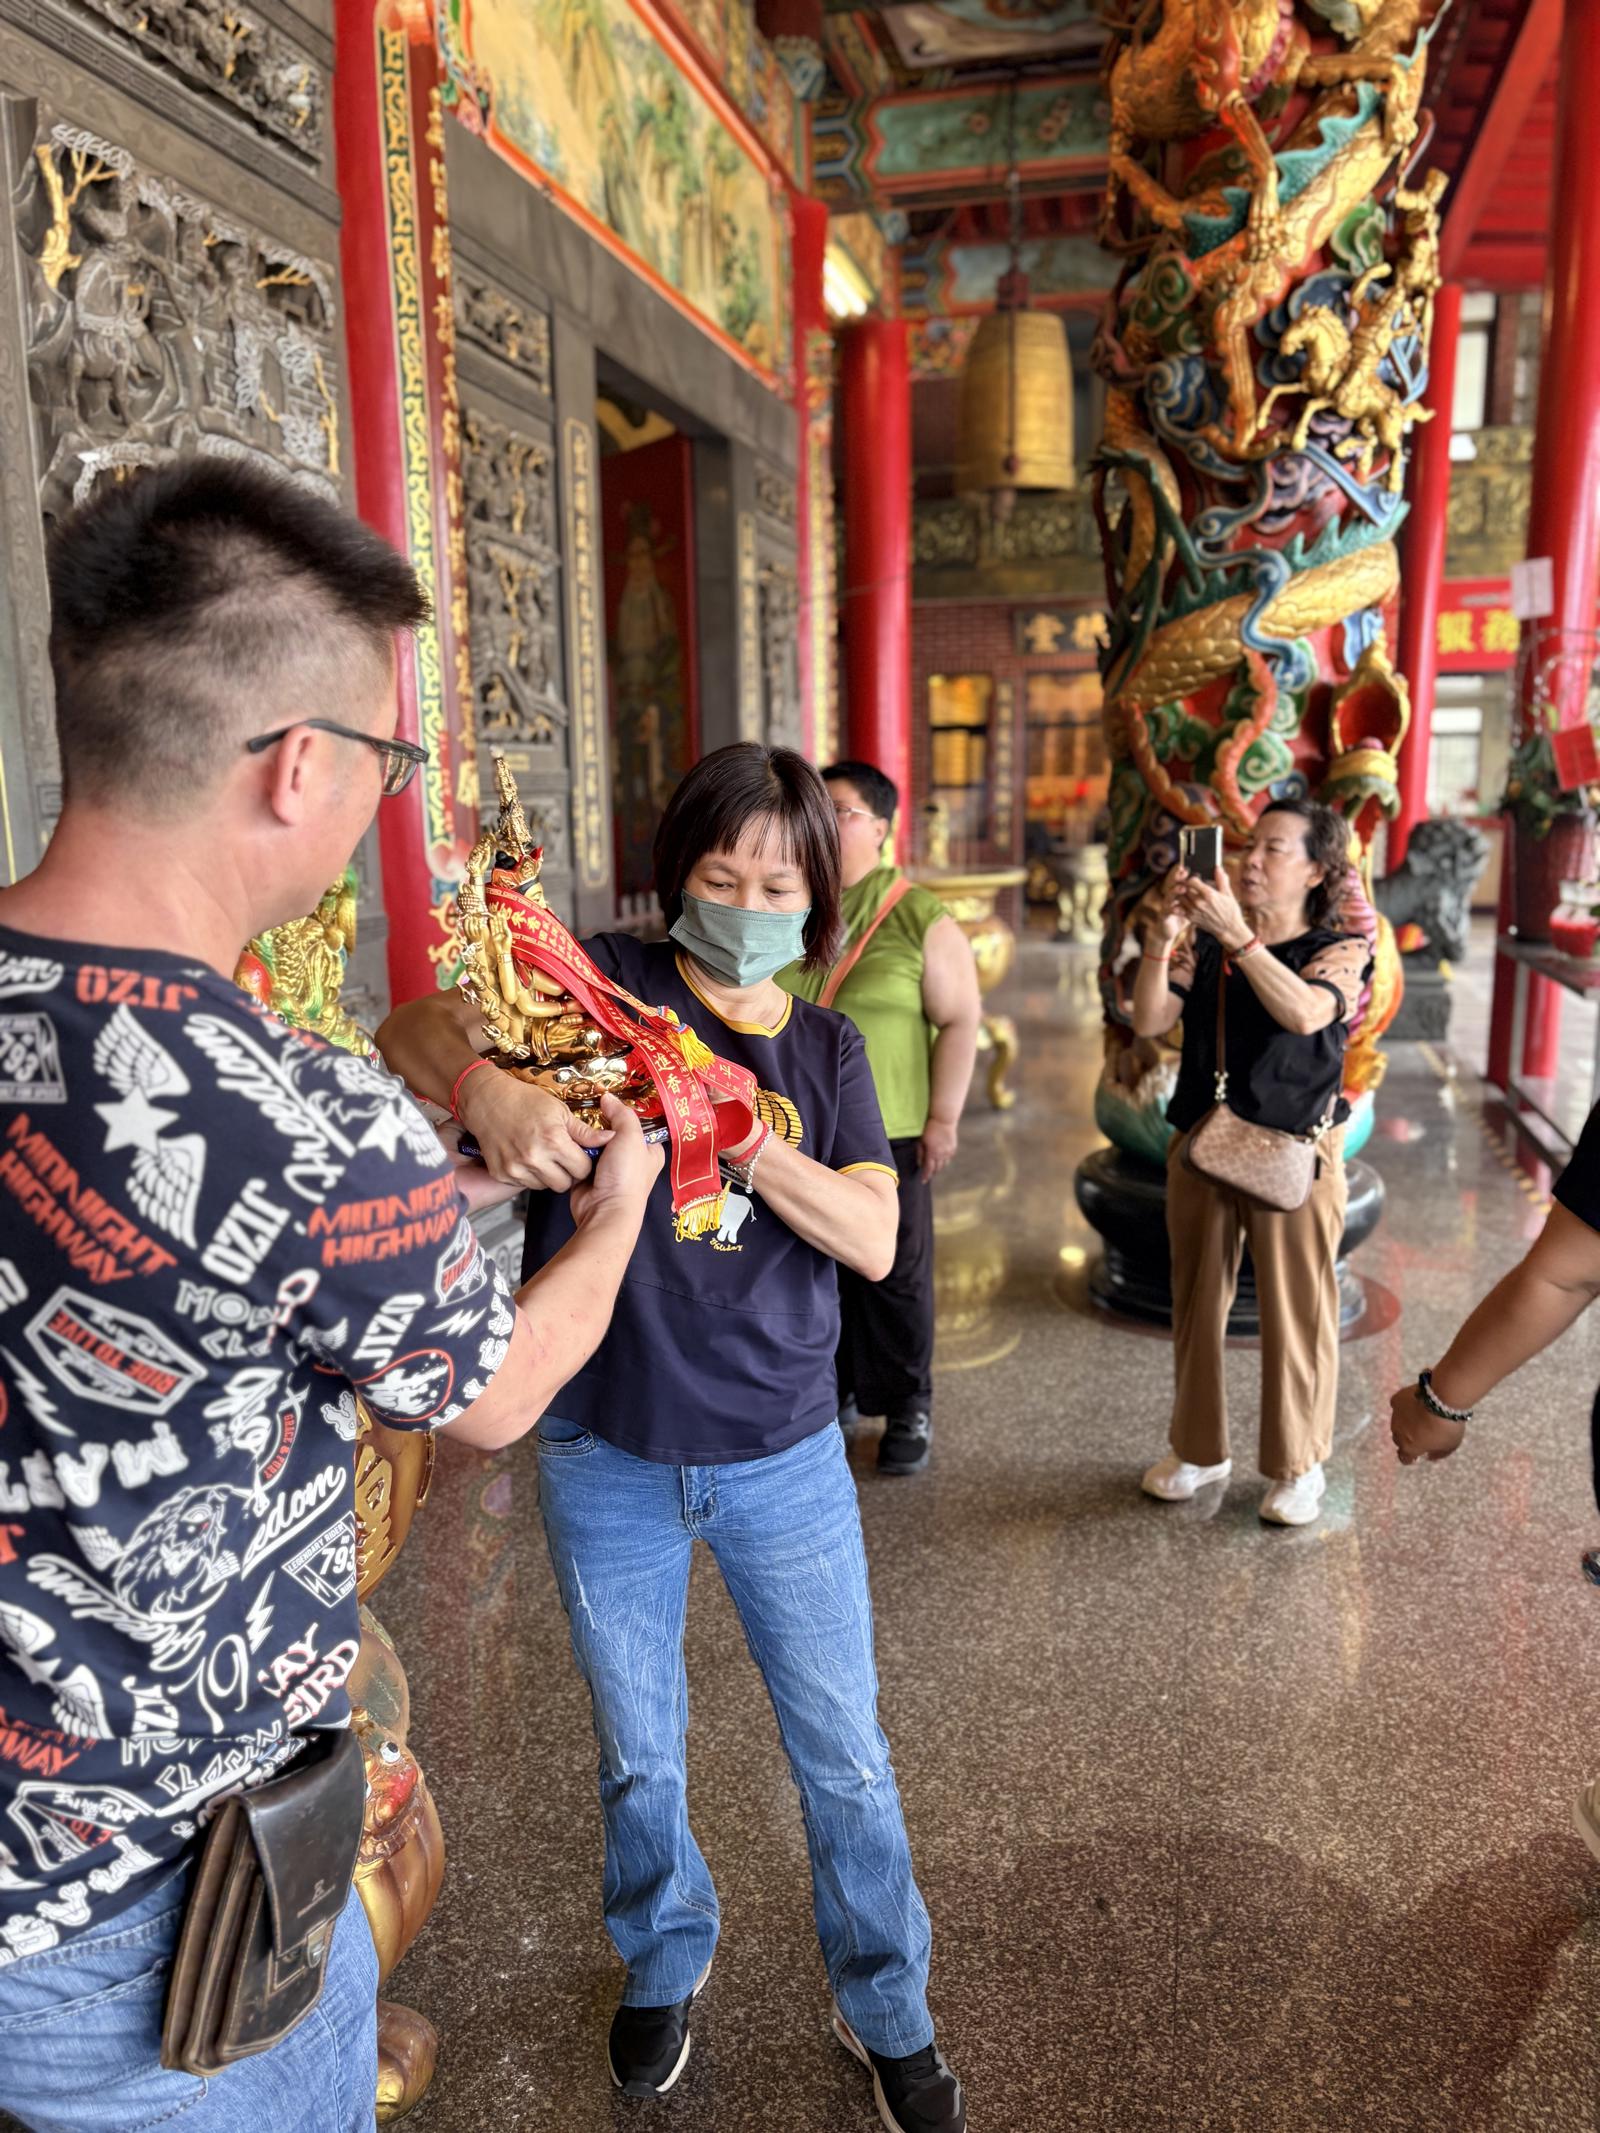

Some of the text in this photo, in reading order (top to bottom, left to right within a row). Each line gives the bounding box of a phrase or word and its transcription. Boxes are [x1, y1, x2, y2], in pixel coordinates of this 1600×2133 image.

[76, 964, 199, 1012] JIZO
[202, 1178, 290, 1285] JIZO
[46, 1310, 98, 1349] LIVE
[94, 1343, 126, 1368] TO
[125, 1359, 178, 1395] RIDE
